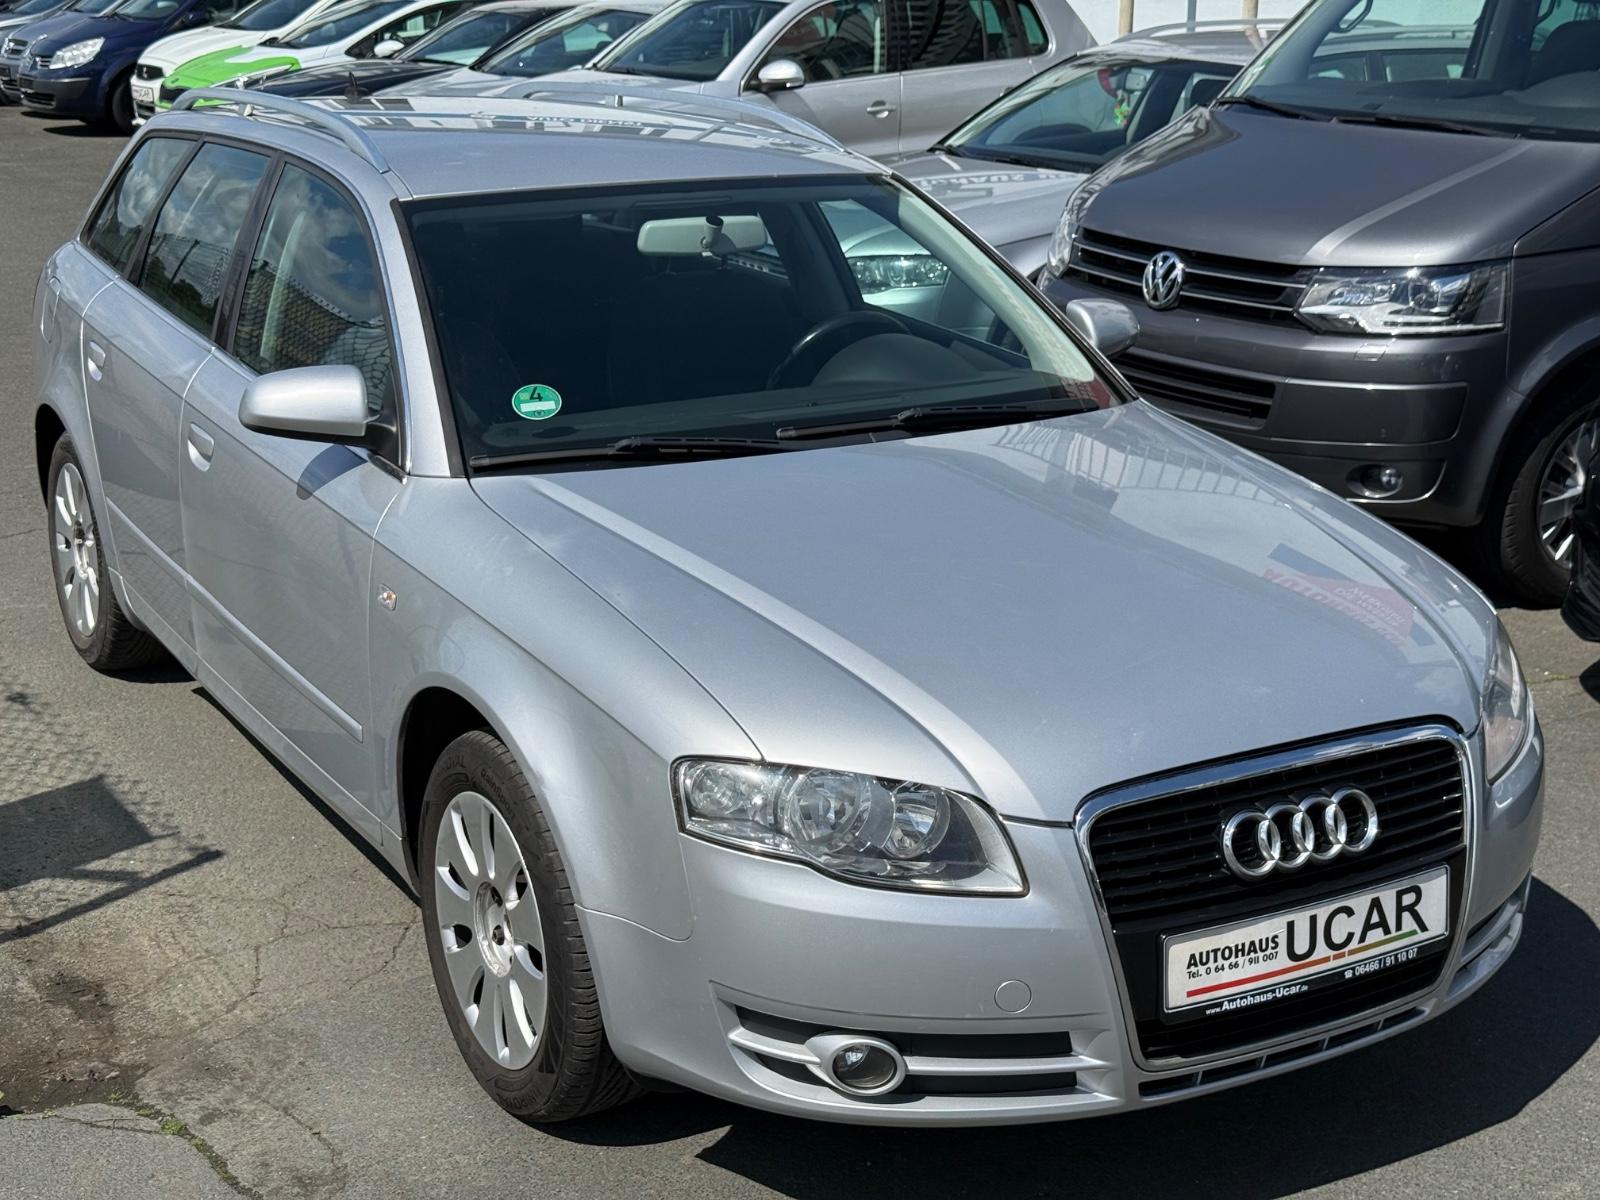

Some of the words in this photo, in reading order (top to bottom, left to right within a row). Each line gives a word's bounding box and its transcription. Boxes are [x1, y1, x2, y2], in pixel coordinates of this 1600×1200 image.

[529, 386, 543, 402] 4
[1286, 884, 1429, 963] UCAR
[1186, 935, 1279, 970] AUTOHAUS
[1187, 970, 1202, 980] Tel.
[1205, 968, 1212, 976] 0
[1214, 964, 1225, 973] 64
[1228, 961, 1240, 970] 66
[1248, 956, 1260, 966] 911
[1262, 951, 1279, 962] 007
[1354, 960, 1380, 976] 06466
[1385, 955, 1395, 967] 91
[1397, 952, 1407, 962] 10
[1408, 948, 1418, 959] 07
[1205, 984, 1308, 1015] www.Autohaus-Ucar.de
